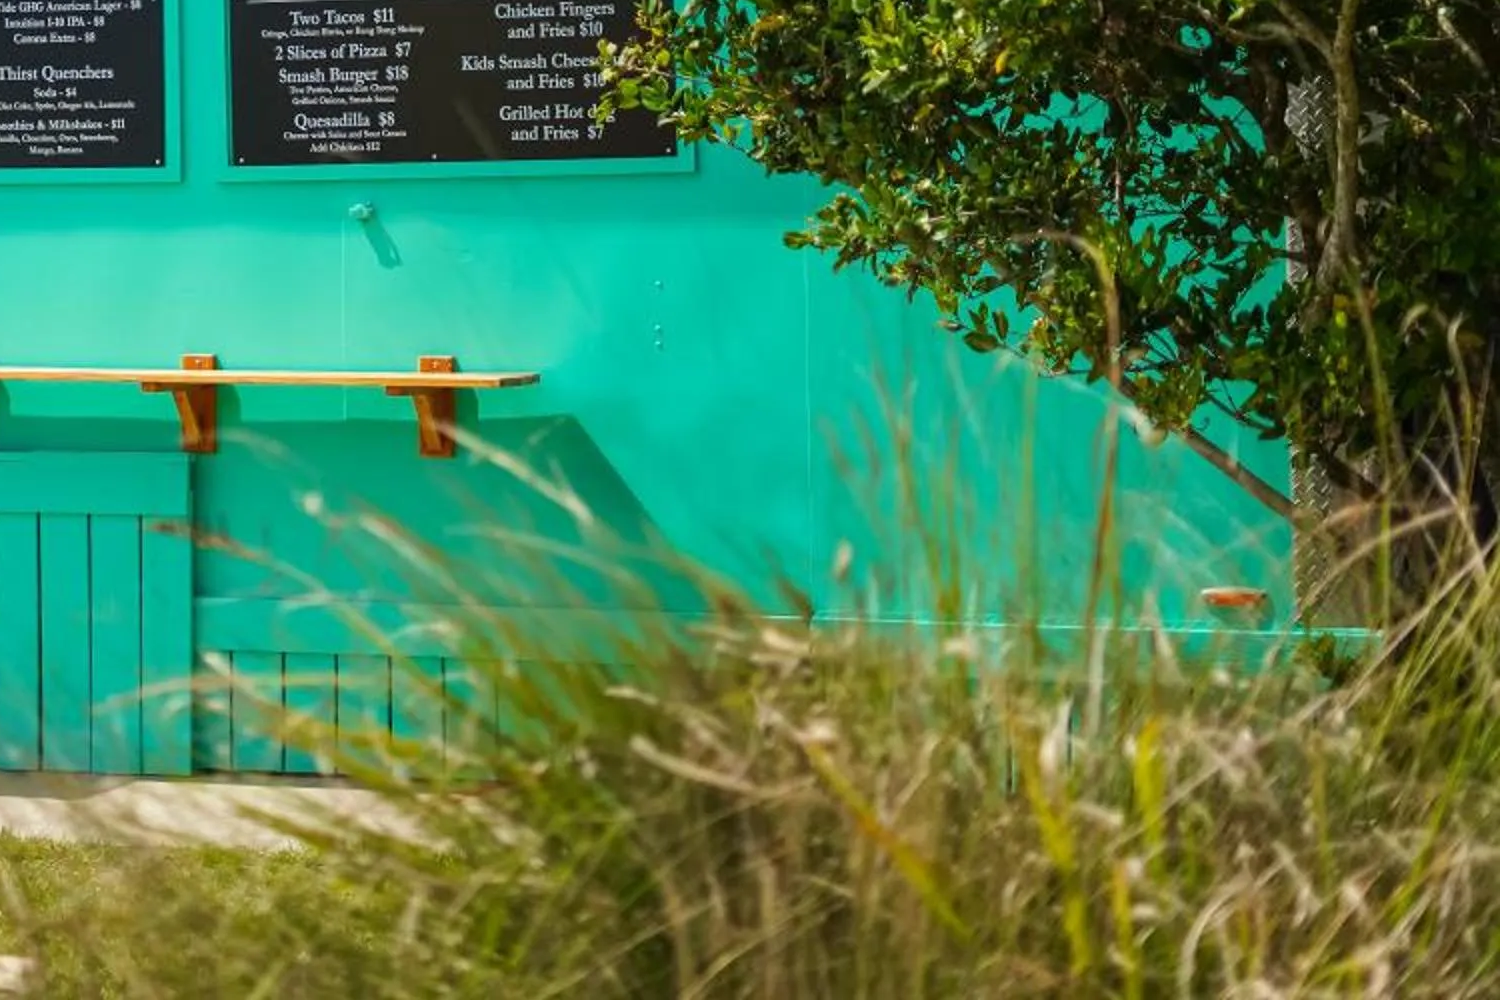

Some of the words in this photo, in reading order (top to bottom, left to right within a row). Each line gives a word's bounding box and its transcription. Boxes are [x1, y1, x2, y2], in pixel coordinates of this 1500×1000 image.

[46, 2, 91, 11] American
[94, 0, 121, 14] Lager
[494, 3, 554, 19] Chicken
[559, 2, 615, 20] Fingers
[67, 16, 86, 26] IPA
[290, 11, 320, 26] Two
[324, 9, 364, 25] Tacos
[373, 8, 394, 23] $11
[14, 33, 47, 44] Corona
[50, 32, 75, 43] Extra
[508, 23, 535, 39] and
[540, 24, 575, 38] Fries
[579, 22, 603, 37] $10
[275, 46, 283, 61] 2
[287, 45, 326, 61] Slices
[331, 44, 344, 59] of
[349, 44, 387, 58] Pizza
[395, 42, 411, 58] $7
[461, 56, 494, 71] Kids
[499, 54, 547, 69] Smash
[41, 65, 114, 82] Quenchers
[279, 67, 325, 83] Smash
[330, 67, 378, 85] Burger
[507, 75, 534, 89] and
[538, 74, 575, 88] Fries
[34, 88, 56, 97] Soda
[66, 87, 77, 96] $4
[294, 112, 370, 130] Quesadilla
[378, 112, 395, 127] $8
[500, 105, 549, 121] Grilled
[555, 104, 583, 119] Hot
[587, 104, 616, 122] dg
[37, 120, 45, 130] &
[49, 119, 102, 130] Milkshakes
[111, 118, 125, 129] $11
[511, 126, 538, 141] and
[543, 125, 579, 140] Fries
[587, 126, 603, 140] $7
